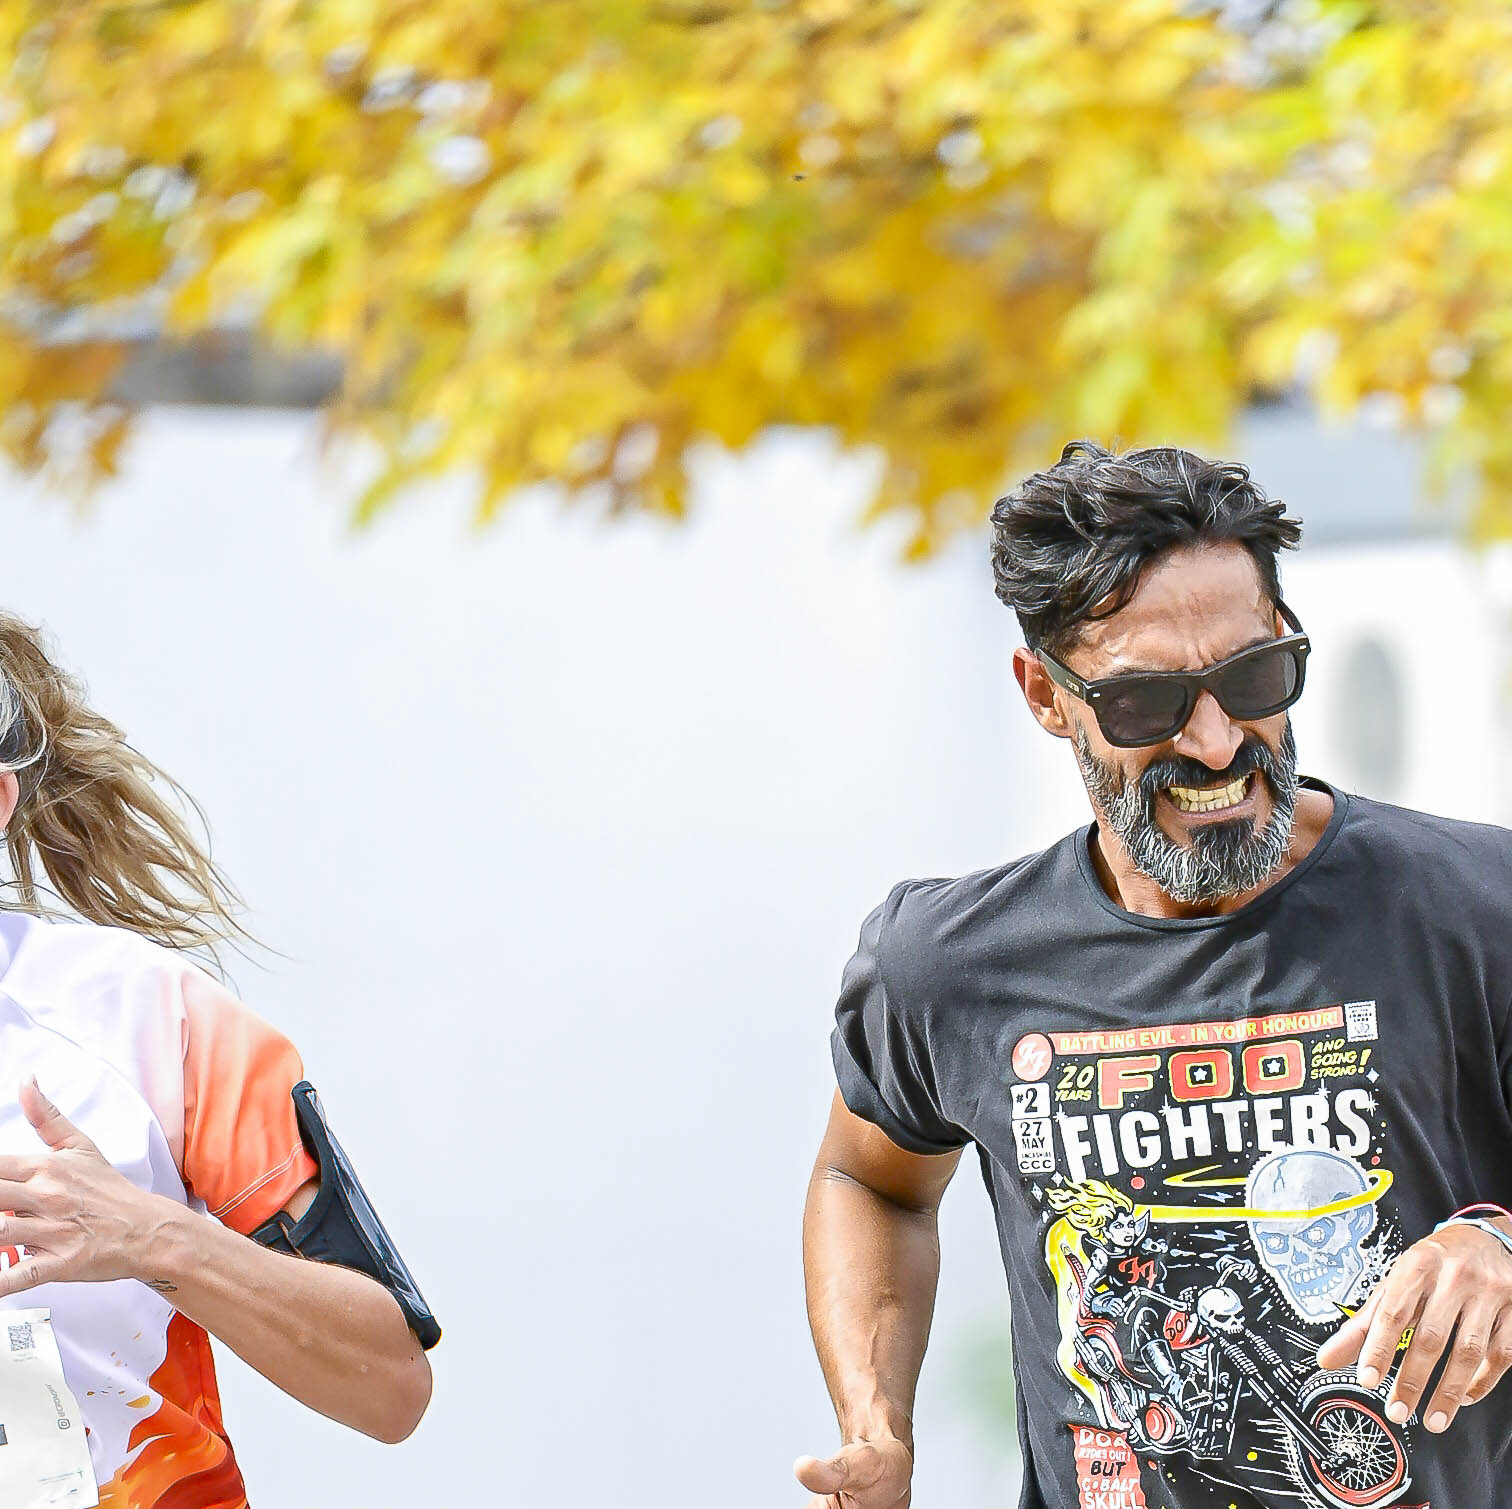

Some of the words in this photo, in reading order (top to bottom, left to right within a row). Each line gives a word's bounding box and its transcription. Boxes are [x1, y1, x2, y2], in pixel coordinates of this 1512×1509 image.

[1060, 1033, 1136, 1051] BATTLING
[1140, 1028, 1176, 1046] EVIL
[1190, 1027, 1208, 1042] IN
[1213, 1022, 1257, 1041] YOUR
[1262, 1010, 1338, 1035] HONOUR!
[1312, 1038, 1346, 1054] AND
[1311, 1050, 1358, 1067] GOING
[1057, 1065, 1095, 1089] 20
[1097, 1040, 1305, 1110] FOO
[1016, 1087, 1038, 1113] #2
[1055, 1089, 1092, 1101] YEARS
[1020, 1121, 1042, 1136] 27
[1059, 1088, 1371, 1183] FIGHTERS
[1022, 1136, 1045, 1149] MAY
[1020, 1160, 1052, 1169] CCC
[1091, 1461, 1126, 1476] BUT
[1082, 1477, 1140, 1492] COBALT
